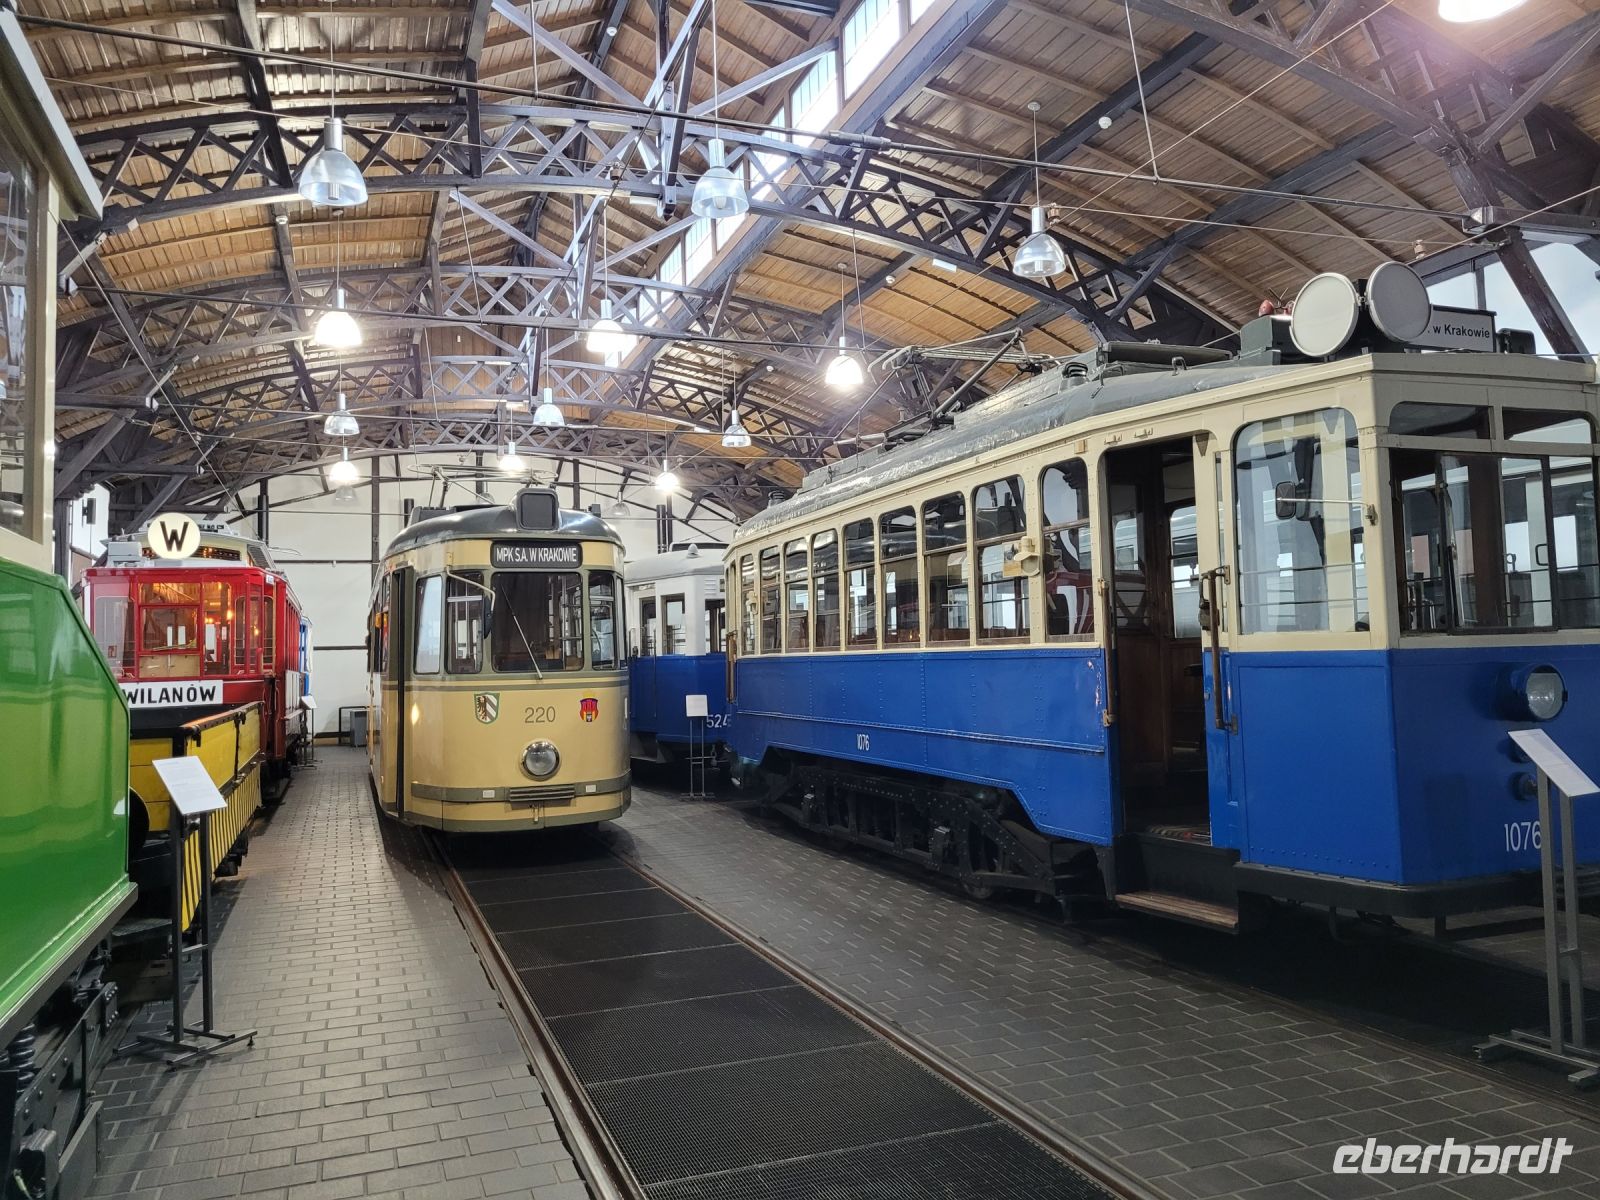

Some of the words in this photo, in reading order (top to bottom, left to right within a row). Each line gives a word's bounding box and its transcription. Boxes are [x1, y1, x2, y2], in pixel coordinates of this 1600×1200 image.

[1433, 325, 1442, 334] w
[1444, 324, 1490, 338] Krakowie
[160, 521, 189, 552] W
[496, 547, 514, 562] MPK
[529, 547, 538, 562] W
[539, 547, 577, 562] KRAKOWIE
[525, 706, 556, 723] 220
[856, 733, 870, 751] 1076
[1504, 821, 1542, 852] 1076
